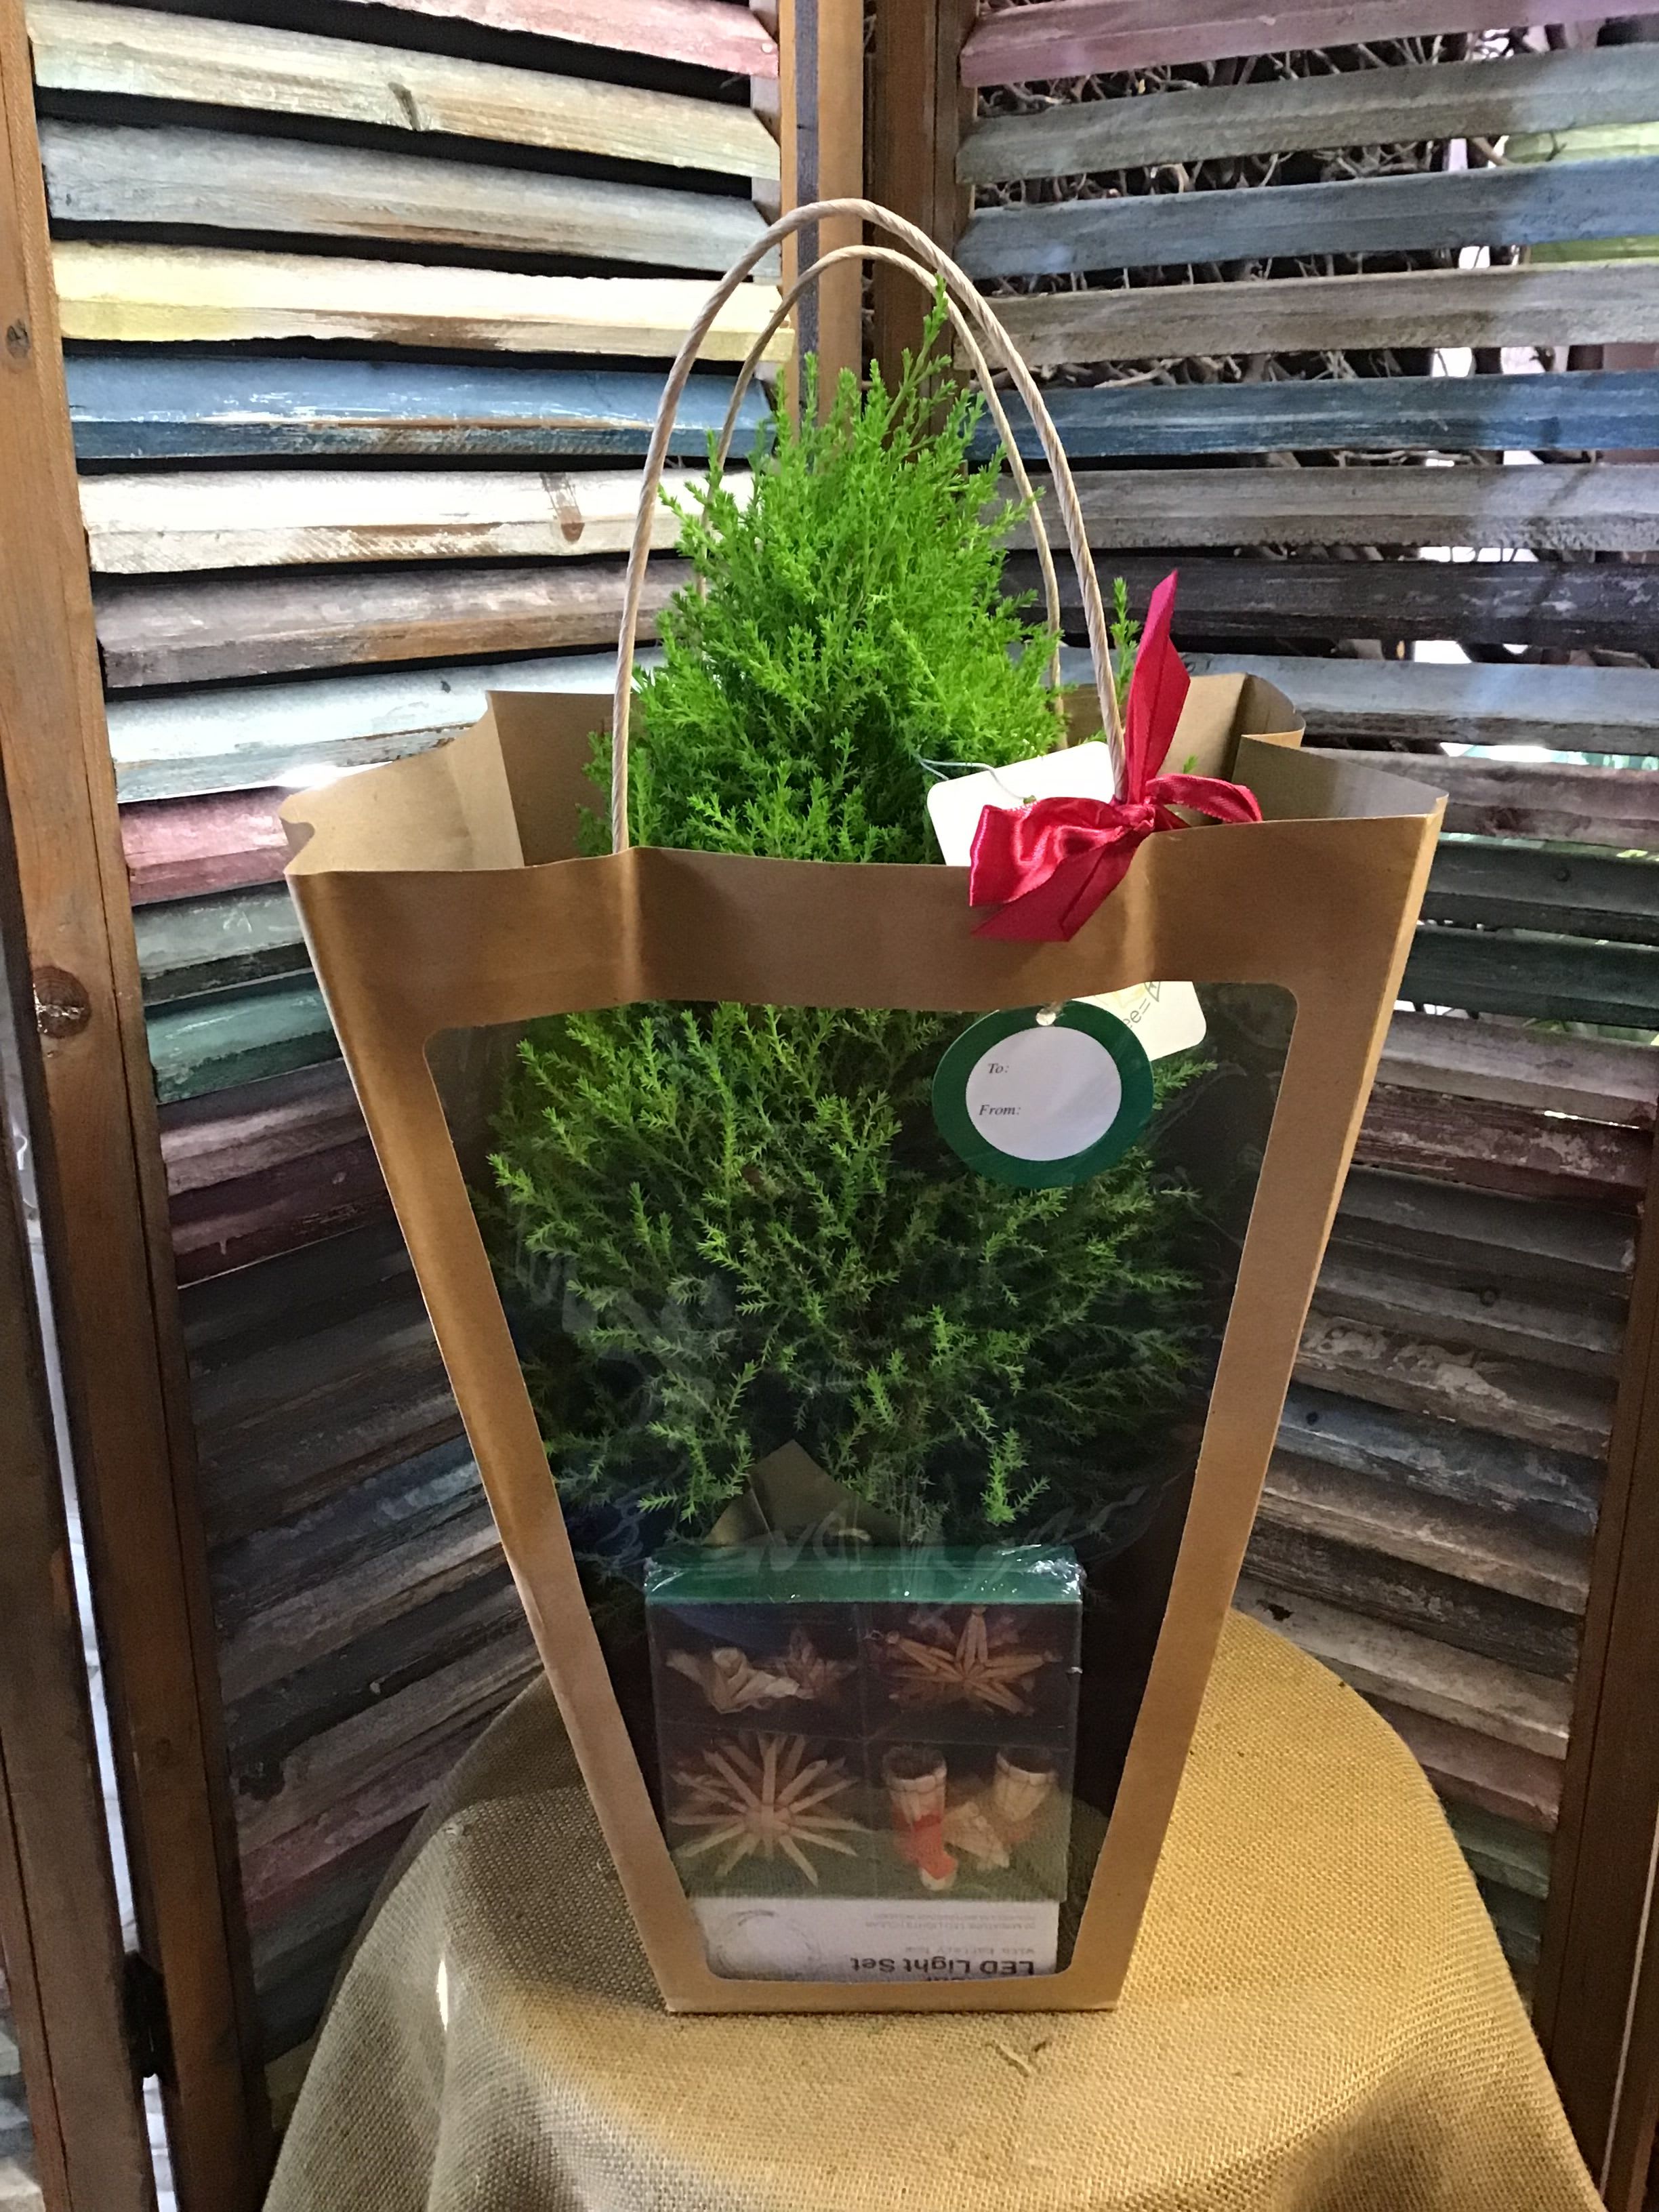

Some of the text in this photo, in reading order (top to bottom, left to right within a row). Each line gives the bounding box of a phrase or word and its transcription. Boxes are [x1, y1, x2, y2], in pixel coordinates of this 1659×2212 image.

[988, 1063, 1010, 1074] To:
[979, 1104, 1021, 1116] From:
[850, 1955, 1035, 1975] LED Light Set
